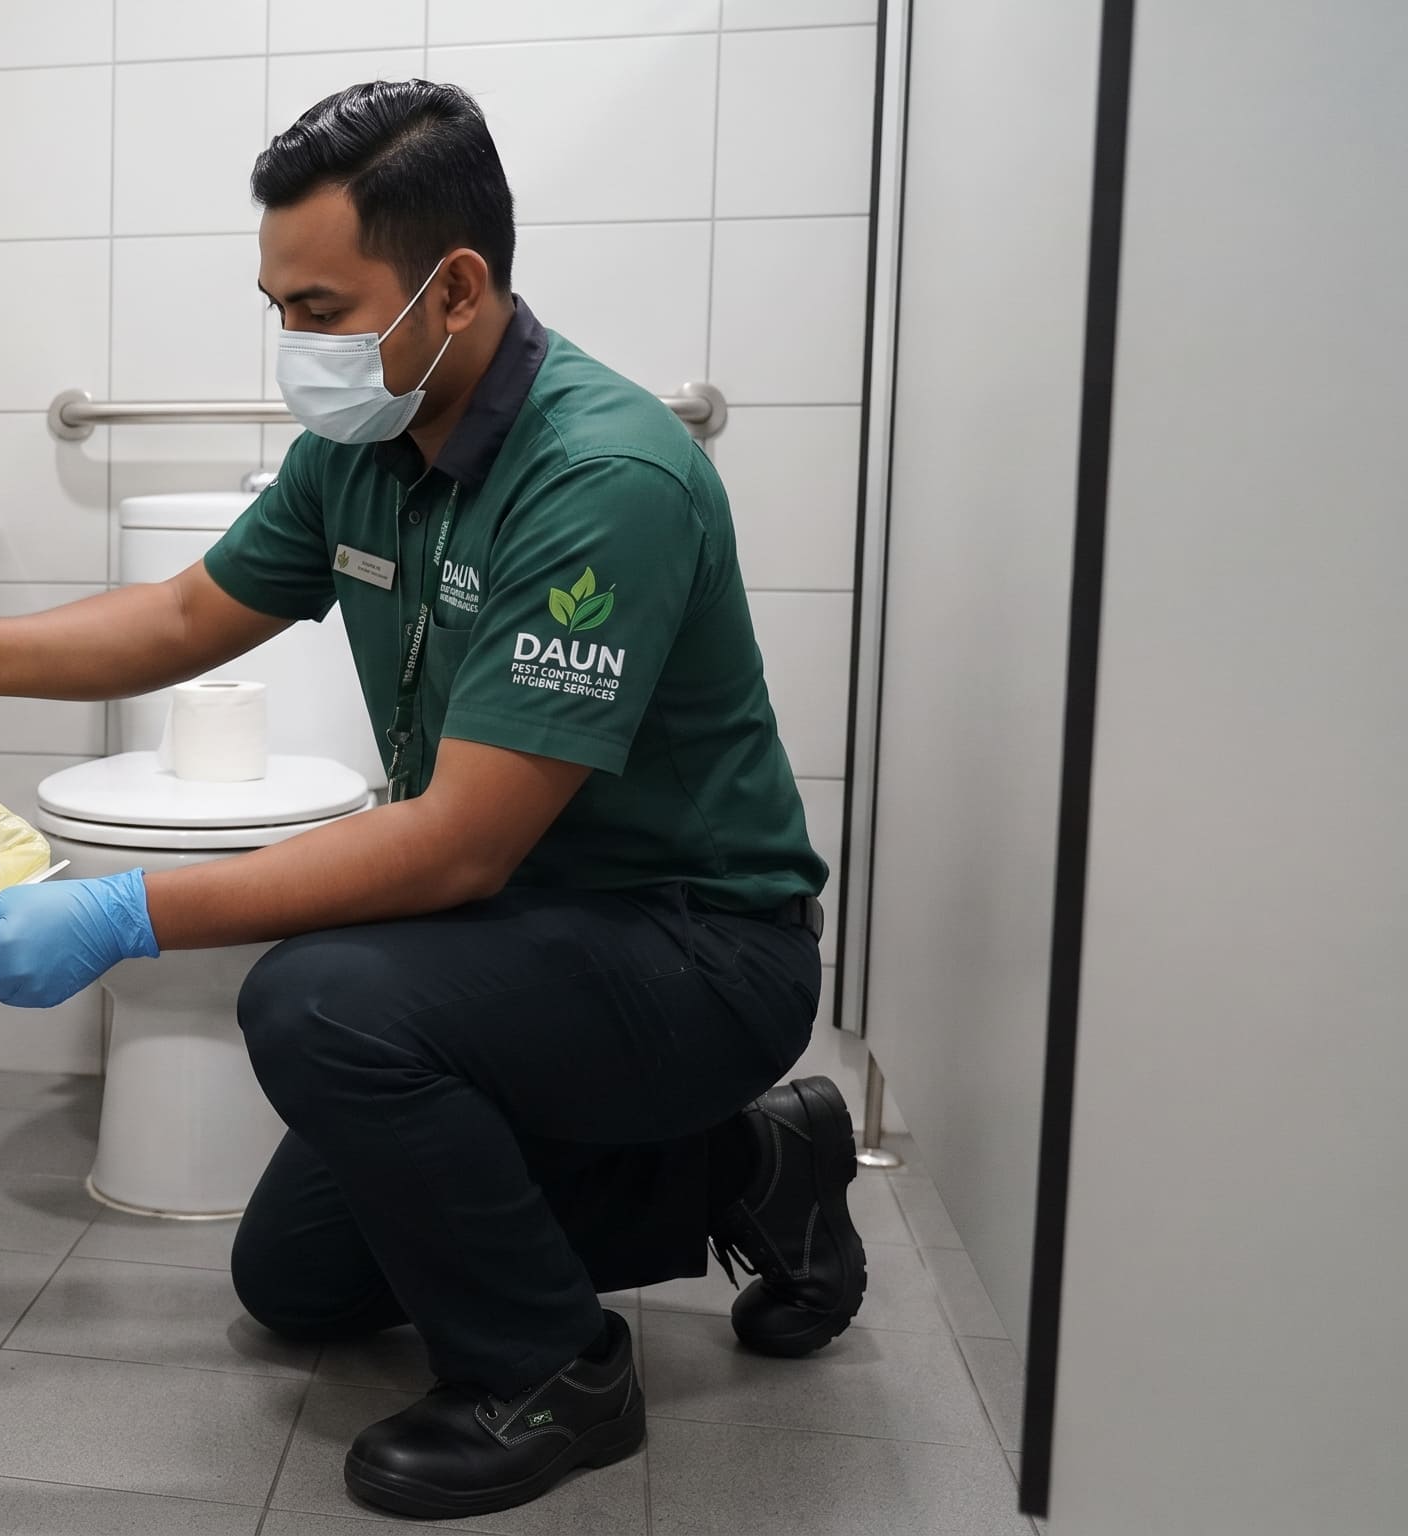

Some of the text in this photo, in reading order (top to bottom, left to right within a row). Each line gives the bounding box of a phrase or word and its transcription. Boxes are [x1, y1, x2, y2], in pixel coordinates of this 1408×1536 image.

[442, 560, 480, 592] DAUN
[513, 632, 626, 677] DAUN
[511, 662, 620, 689] PEST CONTROL AND
[563, 682, 616, 701] SERVICES
